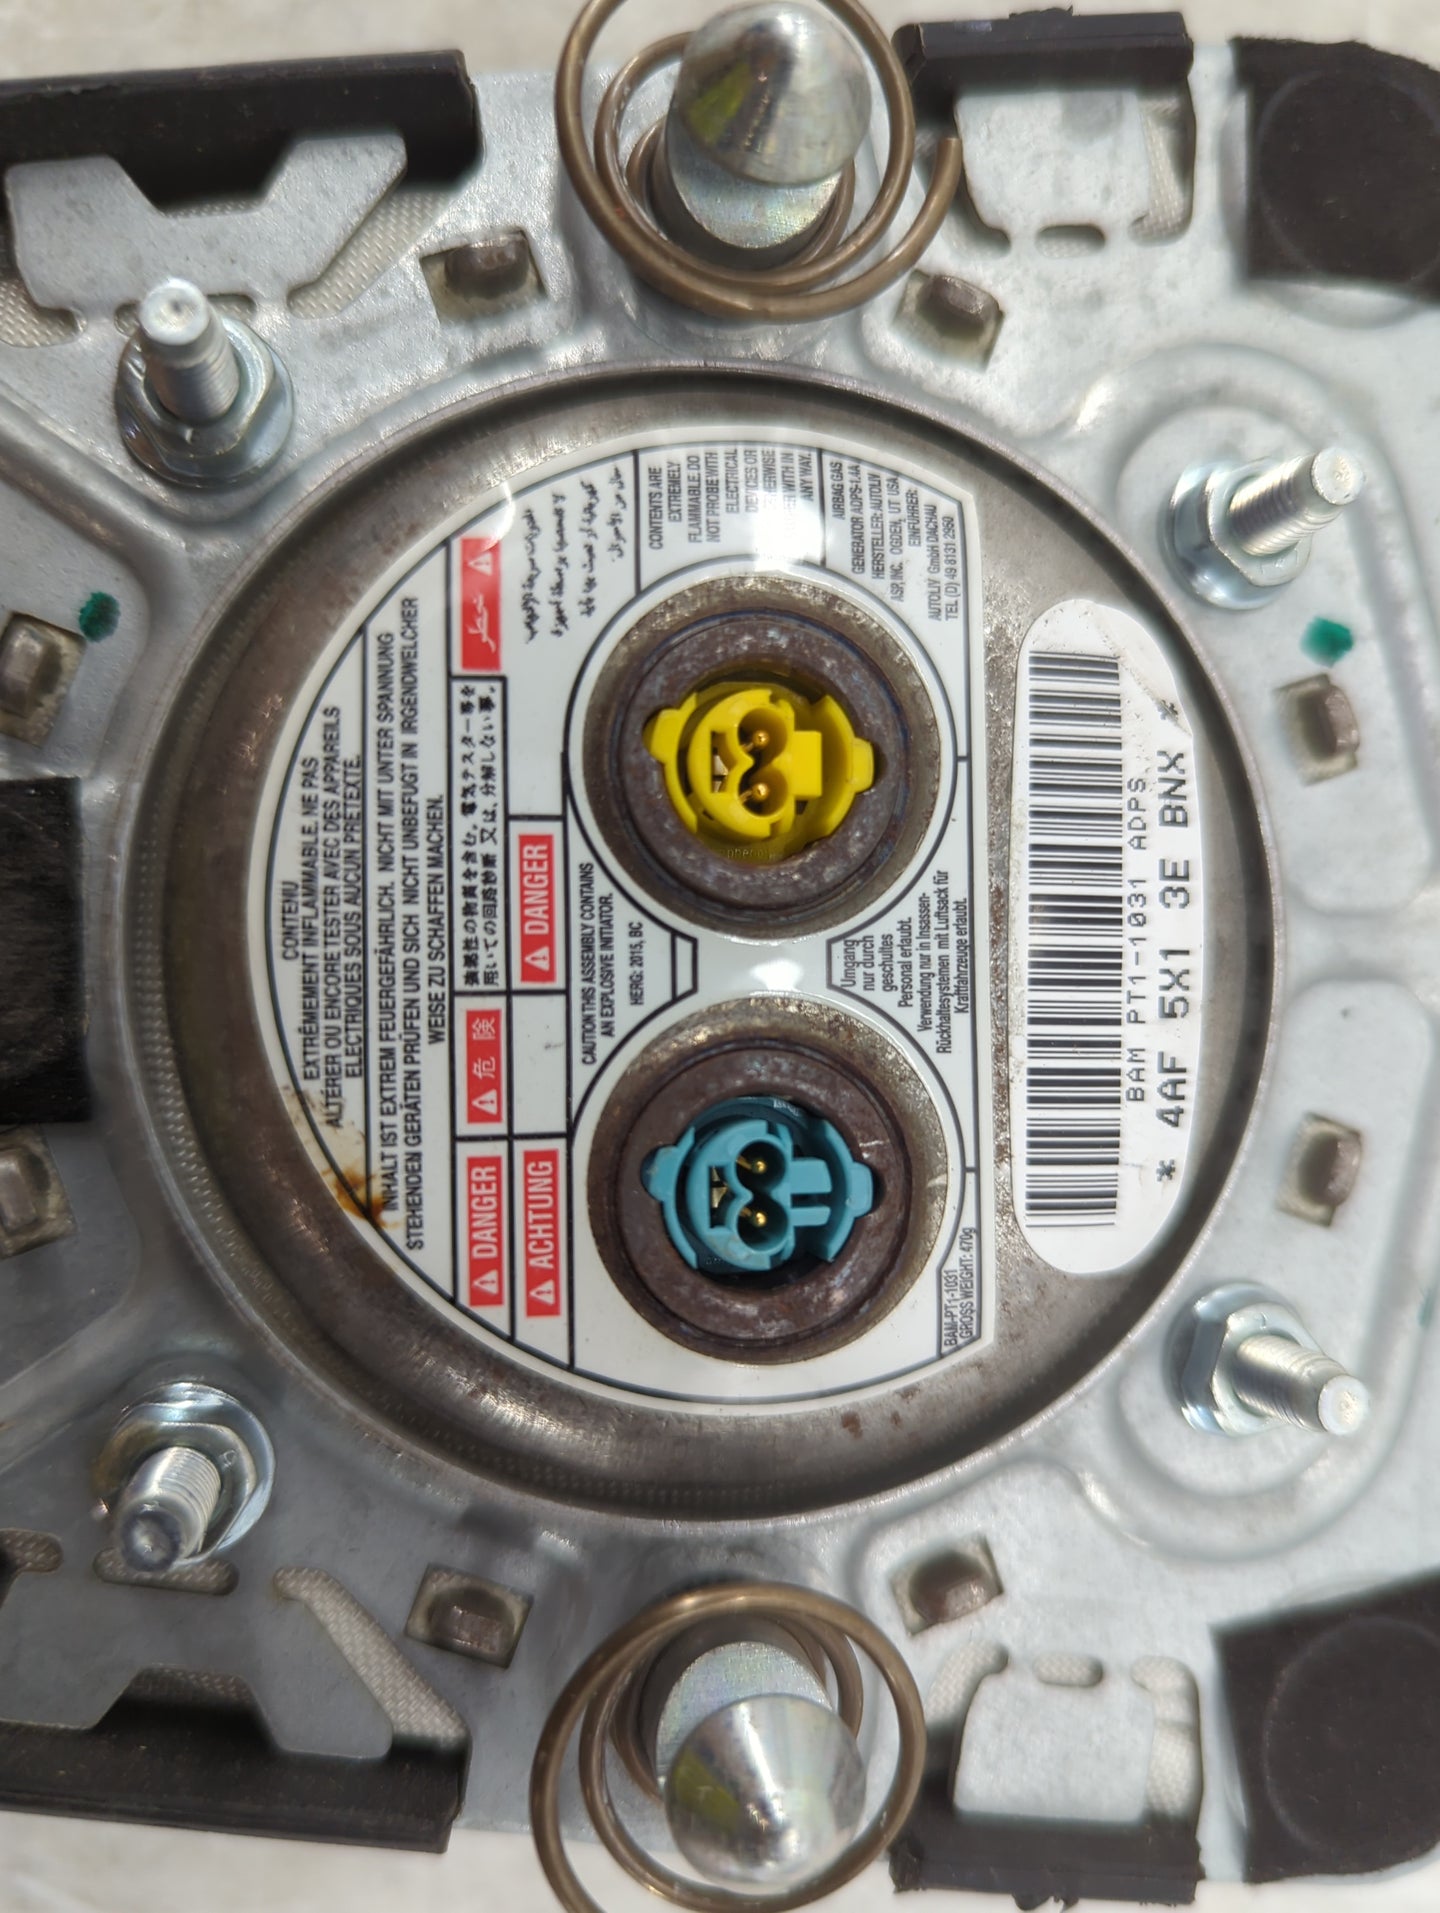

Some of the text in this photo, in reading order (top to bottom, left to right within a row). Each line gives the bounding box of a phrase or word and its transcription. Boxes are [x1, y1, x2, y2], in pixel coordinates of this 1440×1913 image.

[668, 462, 682, 522] EXTREMELY
[687, 456, 700, 470] DO
[726, 449, 740, 513] ELECTRICAL
[744, 449, 759, 512] DEVICES OR
[780, 452, 794, 463] IN
[782, 466, 796, 492] WITH
[798, 452, 814, 501] ANY WAY.
[830, 462, 846, 520] AIRBAG GAS
[648, 467, 664, 550] CONTENTS ARE
[705, 452, 720, 542] NOT PROBE WITH
[868, 473, 884, 579] HERSTELLER: AUTOLIV
[888, 500, 901, 514] UT
[851, 516, 866, 574] GENERATOR
[890, 562, 904, 580] INC.
[924, 504, 942, 621] AUTOLIV GmbH DACHAU
[943, 543, 956, 566] 8131
[944, 568, 957, 580] 49
[468, 594, 496, 652] خطر
[944, 582, 960, 597] (D)
[945, 600, 958, 620] TEL
[301, 757, 318, 788] PAS
[302, 793, 318, 816] NE
[1156, 749, 1188, 828] BNX
[302, 822, 319, 946] INFLAMMABLE.
[344, 848, 361, 906] AUCUN
[523, 844, 550, 935] DANGER
[1158, 860, 1190, 908] 3E
[282, 881, 300, 960] CONTENU
[320, 707, 342, 1128] ALTÉRER OU ENCORE TESTER AVEC DES APPAREILS
[344, 908, 361, 957] SOUS
[374, 633, 399, 1211] INHALT IST EXTREM FEUERGEFÄHRLICH. NICHT MIT UNTER SPANNUNG
[399, 598, 424, 1250] STEHENDEN GERÄTEN PRÜFEN UND SICH NICHT UNBEFUGT IN IRGENDWELCHER
[426, 794, 446, 1044] WEISE ZU SCHAFFEN MACHEN.
[952, 898, 970, 1013] Kraftfahrzeuge erlaubt.
[1127, 776, 1146, 1102] BAM PT1-1031 ADPS
[579, 862, 597, 1064] CAUTION THIS ASSEMBLY CONTAINS
[598, 892, 615, 1037] AN EXPLOSIVE INITIATOR.
[629, 922, 646, 1006] HERG: 2015, BC
[840, 939, 859, 987] Umgang
[860, 936, 875, 991] nur durch
[878, 934, 898, 992] geschultes
[896, 918, 913, 1008] Personal erlaubt.
[916, 893, 934, 1032] Verwendung nur in Insassen-
[932, 870, 954, 1054] Rückhaltesystemen mit Luftsack für
[1158, 948, 1190, 1020] 5X1
[345, 962, 362, 1078] ELECTRIQUES
[1157, 1050, 1188, 1128] 4AF
[471, 1166, 498, 1259] DANGER
[527, 1161, 554, 1269] ACHTUNG
[944, 1269, 958, 1346] BAM-PT1-1031
[959, 1228, 976, 1338] GROSS WEIGHT: 470g
